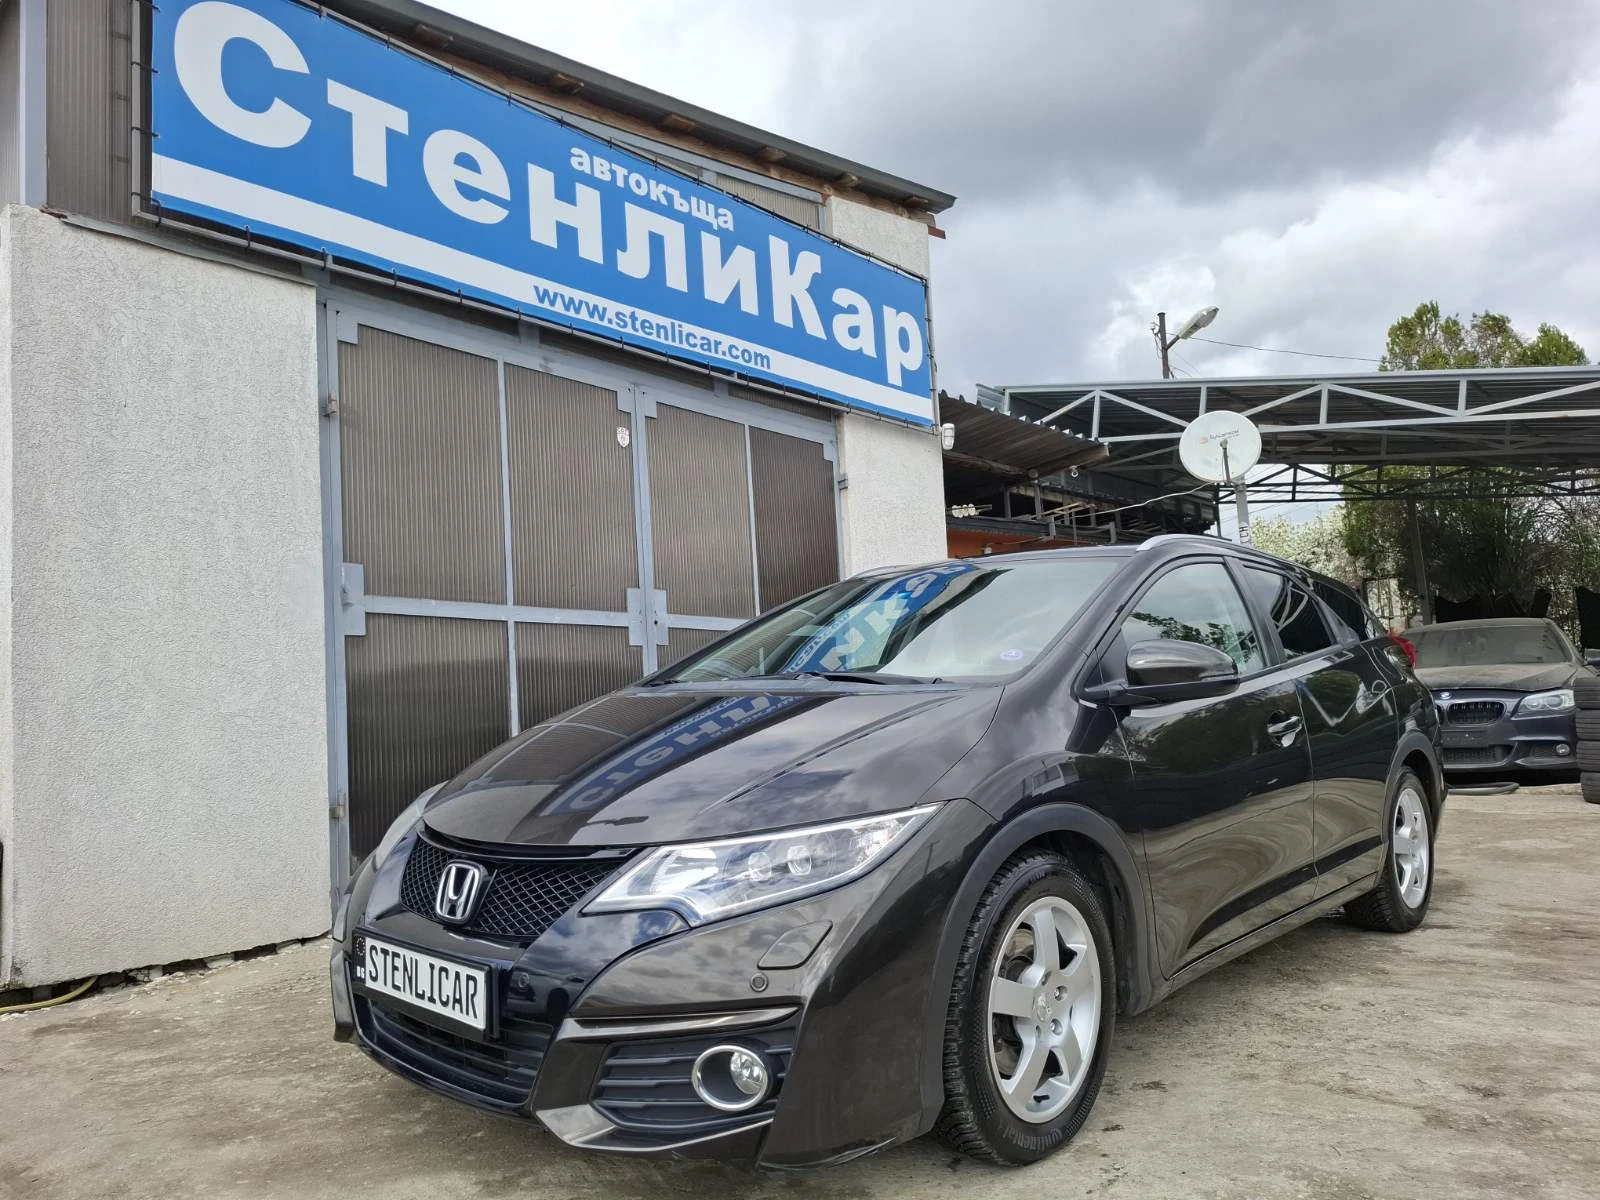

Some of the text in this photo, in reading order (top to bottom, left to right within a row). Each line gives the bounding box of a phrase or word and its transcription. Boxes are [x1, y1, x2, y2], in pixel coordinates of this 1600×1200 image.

[174, 1, 923, 386] СтенлиКар
[570, 147, 734, 231] автокъща
[534, 285, 771, 370] www.stenlicar.com
[369, 945, 478, 1019] STENLICAR
